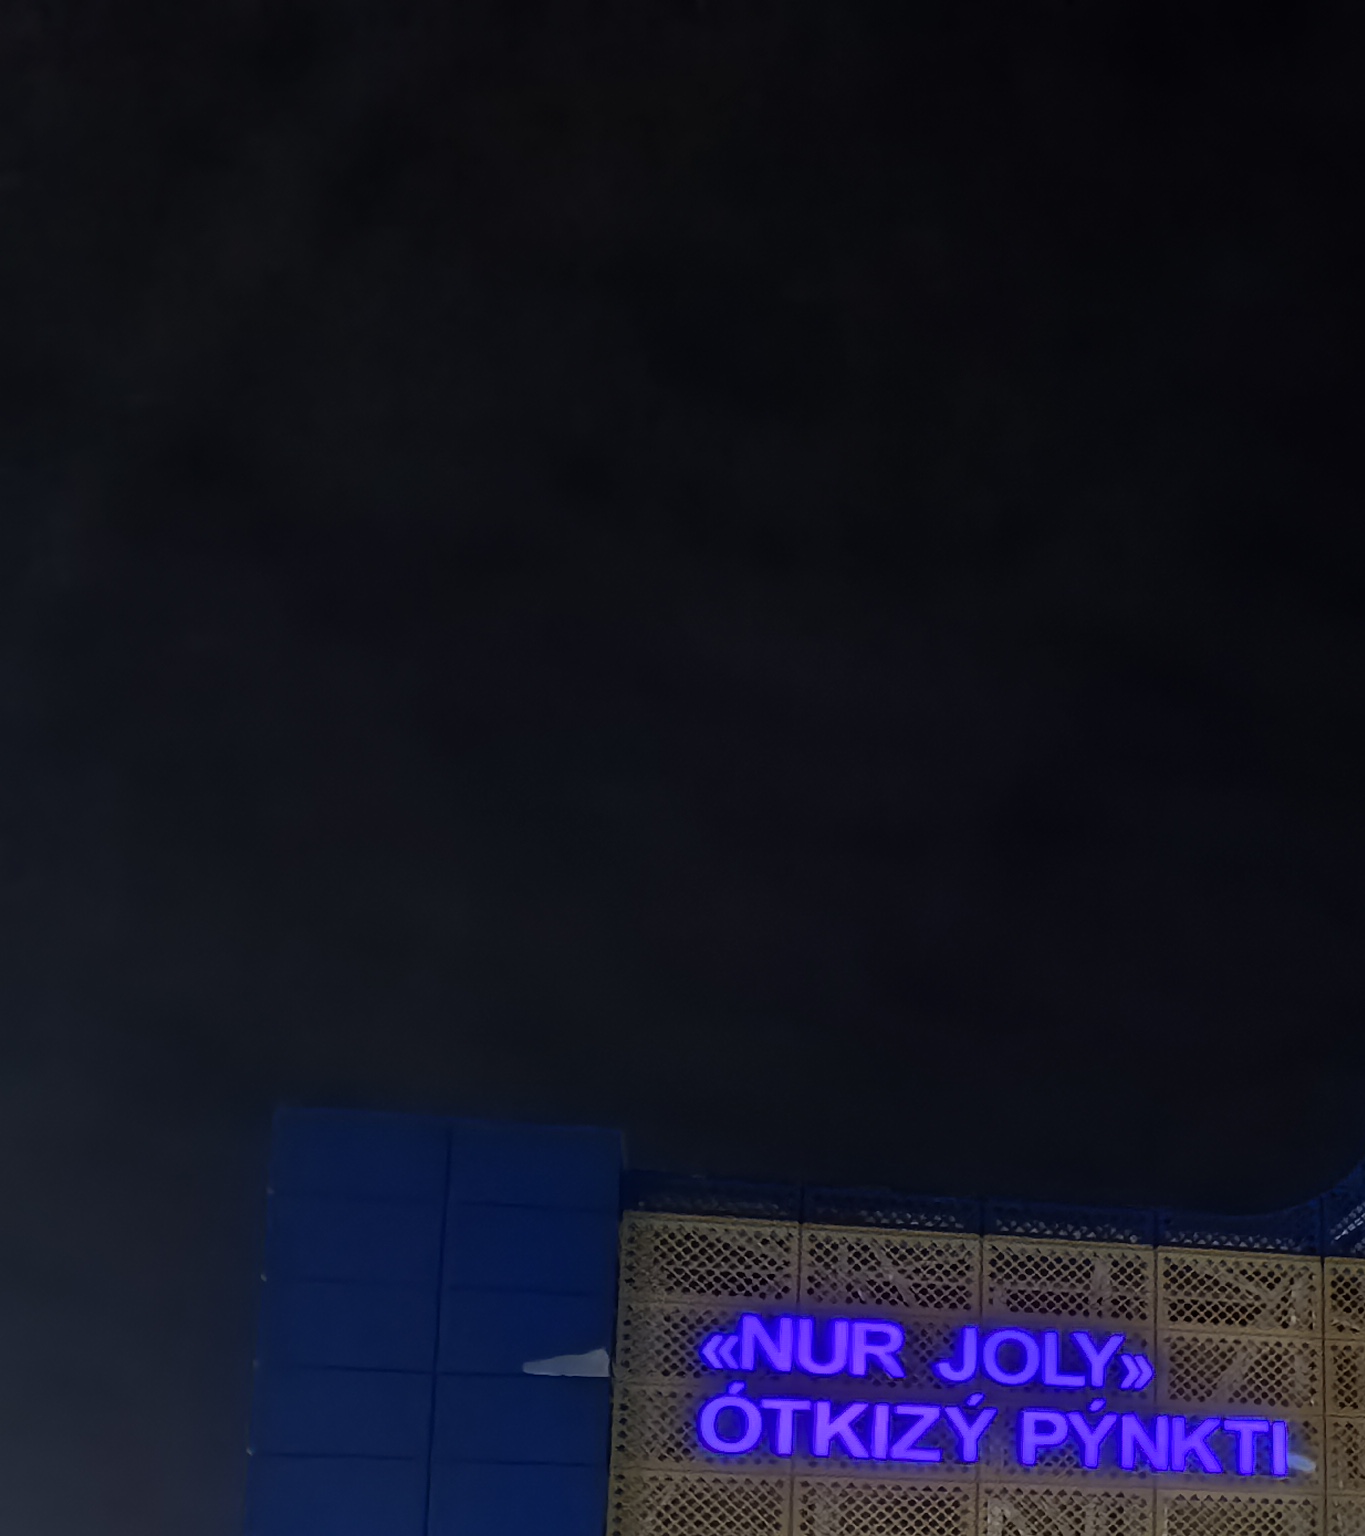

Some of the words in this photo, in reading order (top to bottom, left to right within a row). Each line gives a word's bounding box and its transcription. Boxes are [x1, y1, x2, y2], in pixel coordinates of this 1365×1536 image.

[700, 1314, 905, 1378] «NUR
[934, 1327, 1155, 1391] JOLY»
[697, 1381, 994, 1462] ÓTKIZÝ
[1017, 1399, 1290, 1477] PÝNKTI
